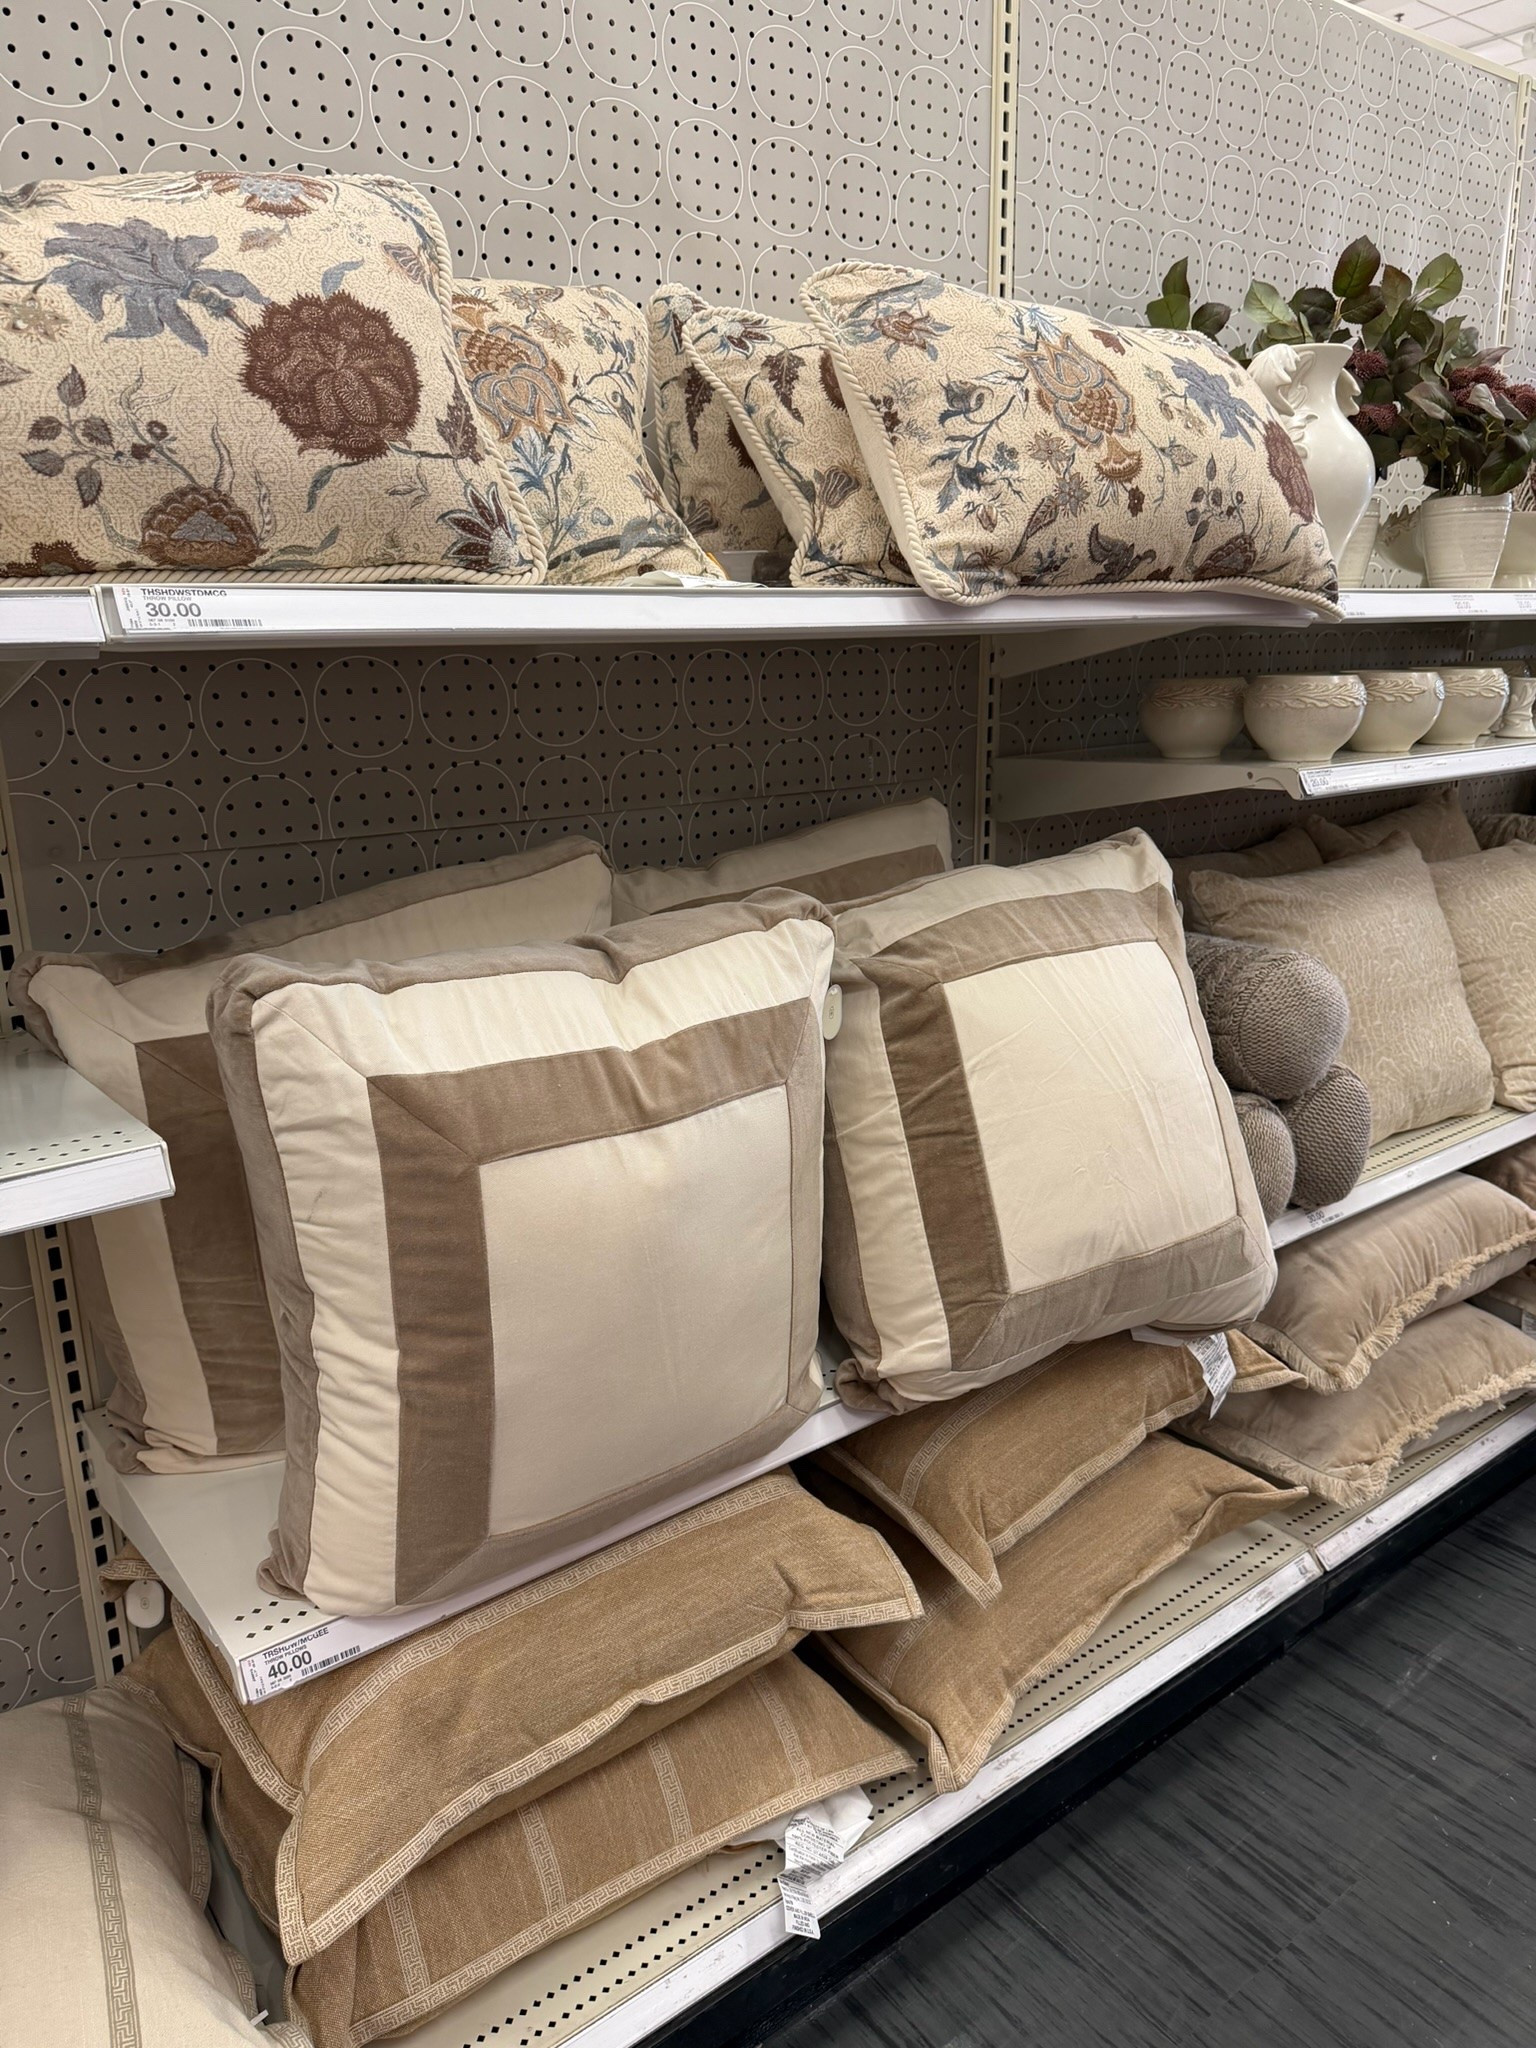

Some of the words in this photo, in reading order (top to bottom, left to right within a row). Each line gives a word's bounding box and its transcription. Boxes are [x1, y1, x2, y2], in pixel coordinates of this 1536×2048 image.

[140, 587, 228, 597] THSHDWSTDMCG
[145, 602, 202, 617] 30.00
[264, 1653, 285, 1666] THROW
[284, 1644, 308, 1658] PILLOWS
[268, 1650, 312, 1679] 40.00
